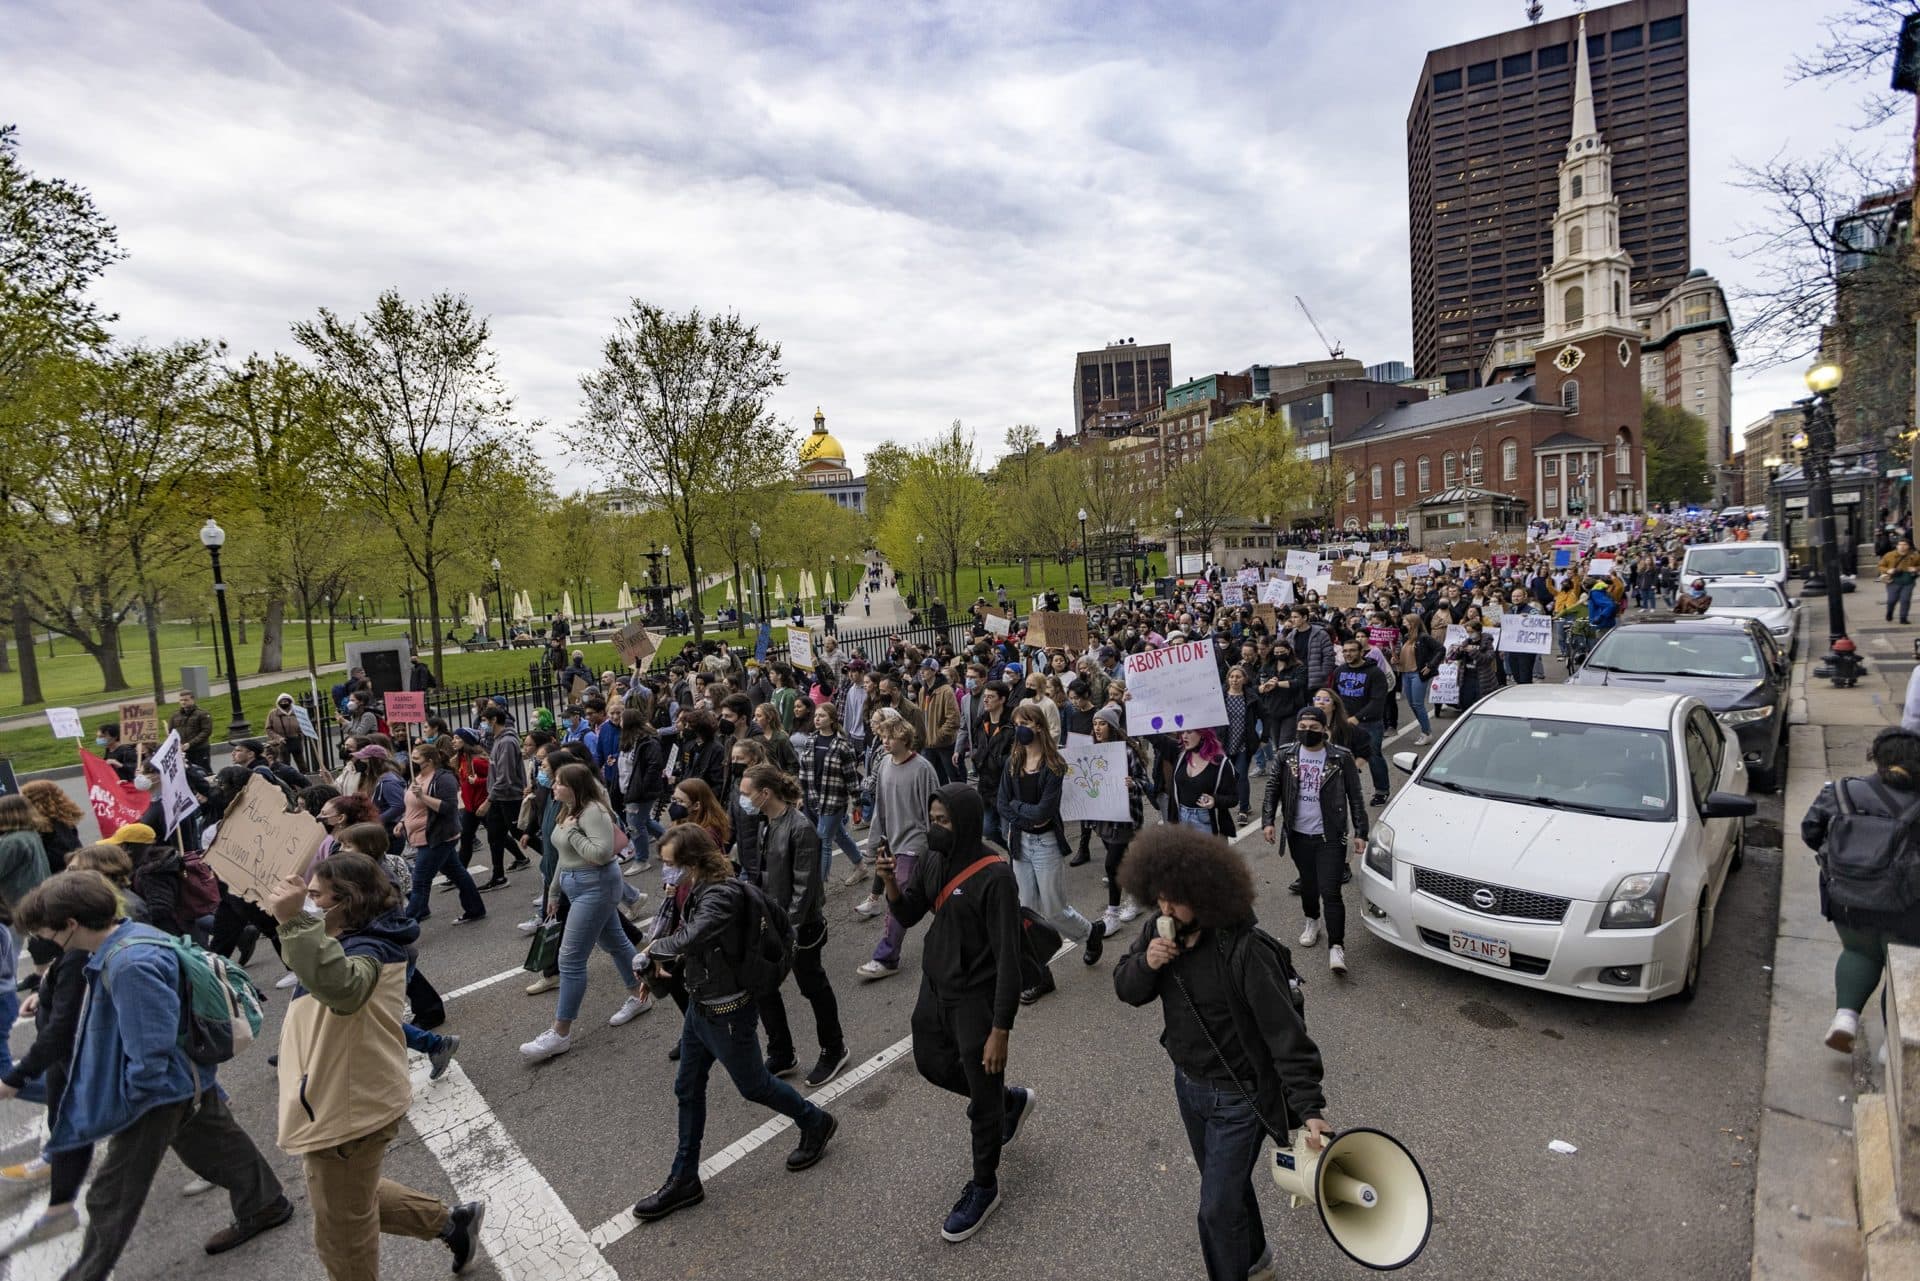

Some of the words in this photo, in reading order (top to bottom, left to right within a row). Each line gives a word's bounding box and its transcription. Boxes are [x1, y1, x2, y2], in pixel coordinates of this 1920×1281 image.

[1521, 617, 1551, 628] CHOICE
[1516, 630, 1549, 645] RIGHT
[1128, 642, 1209, 673] ABORTION:
[123, 720, 144, 736] MY
[1452, 934, 1478, 953] 571
[1481, 941, 1507, 958] NF9
